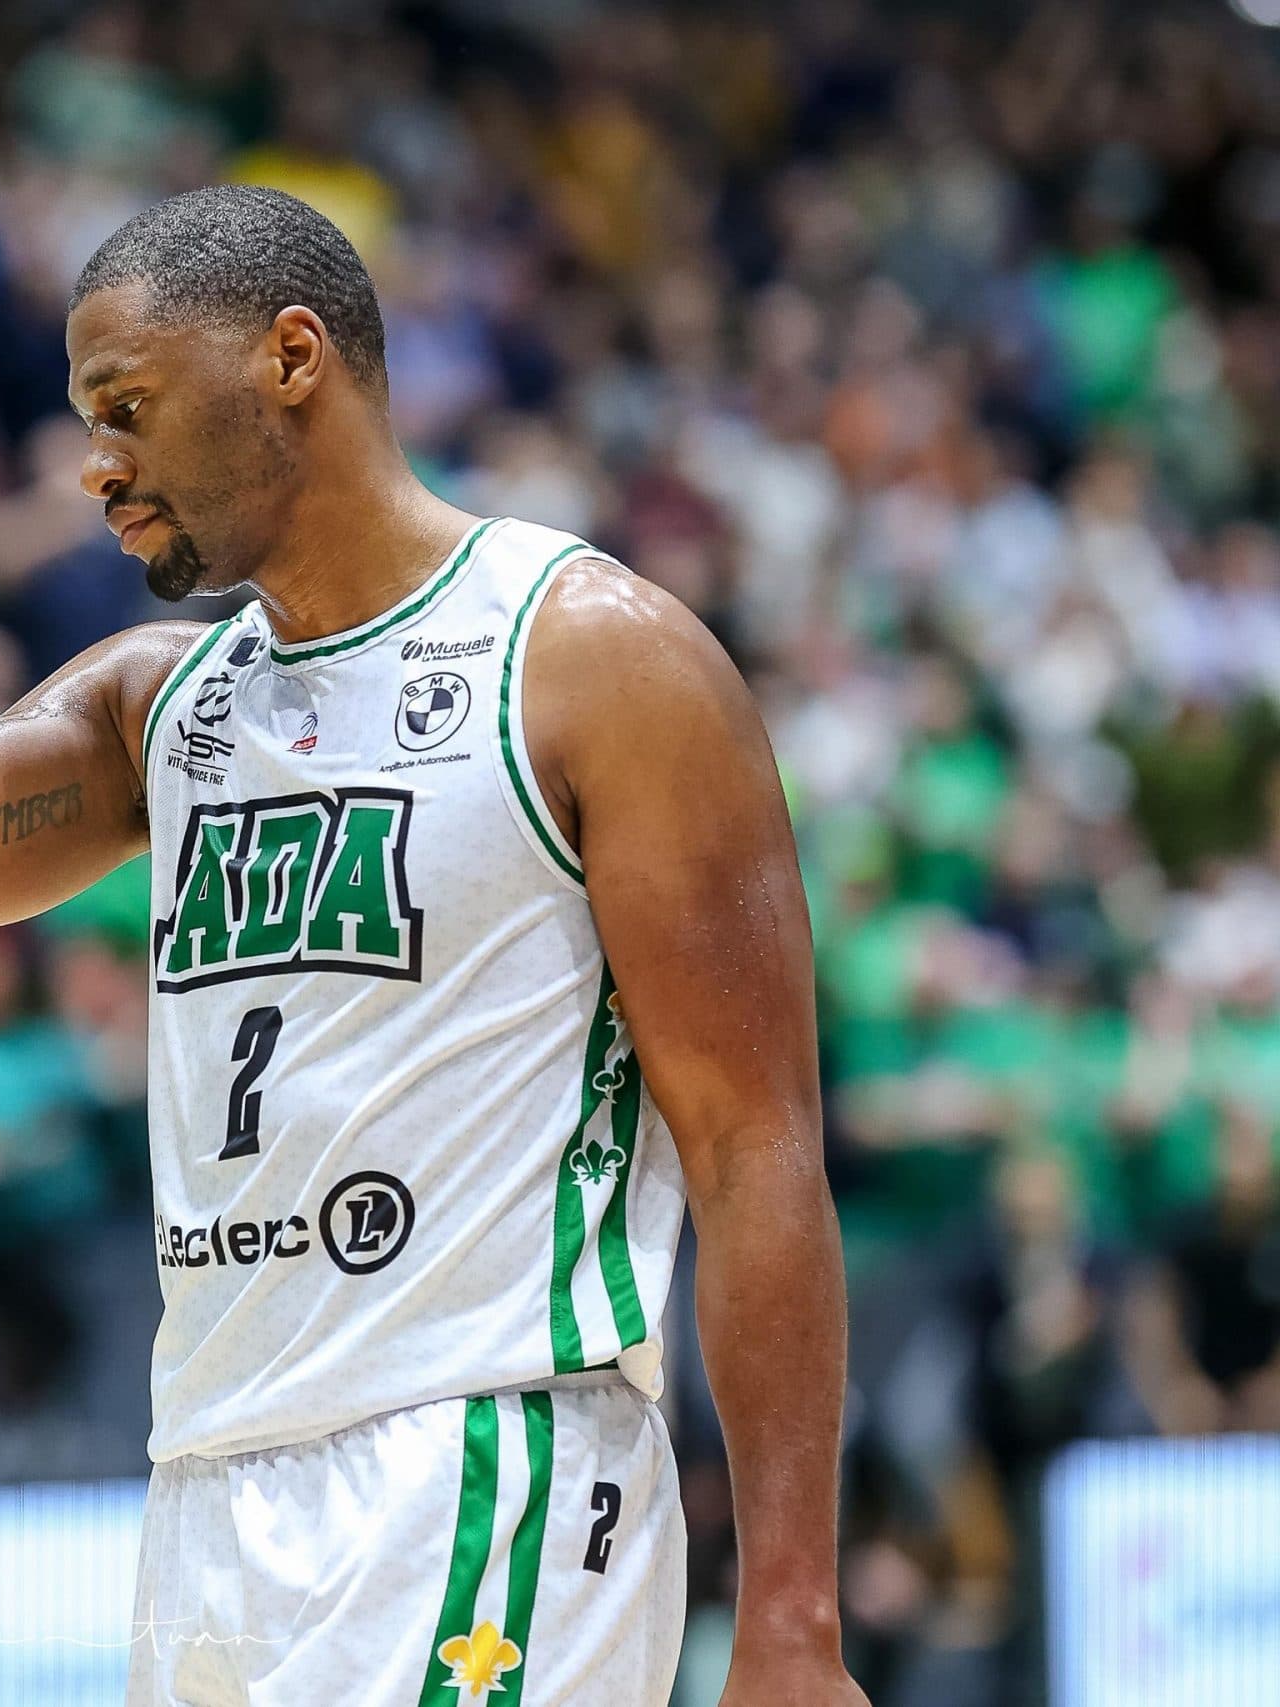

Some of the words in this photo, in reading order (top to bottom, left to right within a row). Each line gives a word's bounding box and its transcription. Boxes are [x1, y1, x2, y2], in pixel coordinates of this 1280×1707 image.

[424, 634, 495, 655] Mutuale
[404, 676, 464, 698] BMW
[416, 753, 472, 767] Automobiles
[156, 790, 422, 990] ADA
[218, 1005, 283, 1162] 2
[583, 1481, 622, 1575] 2
